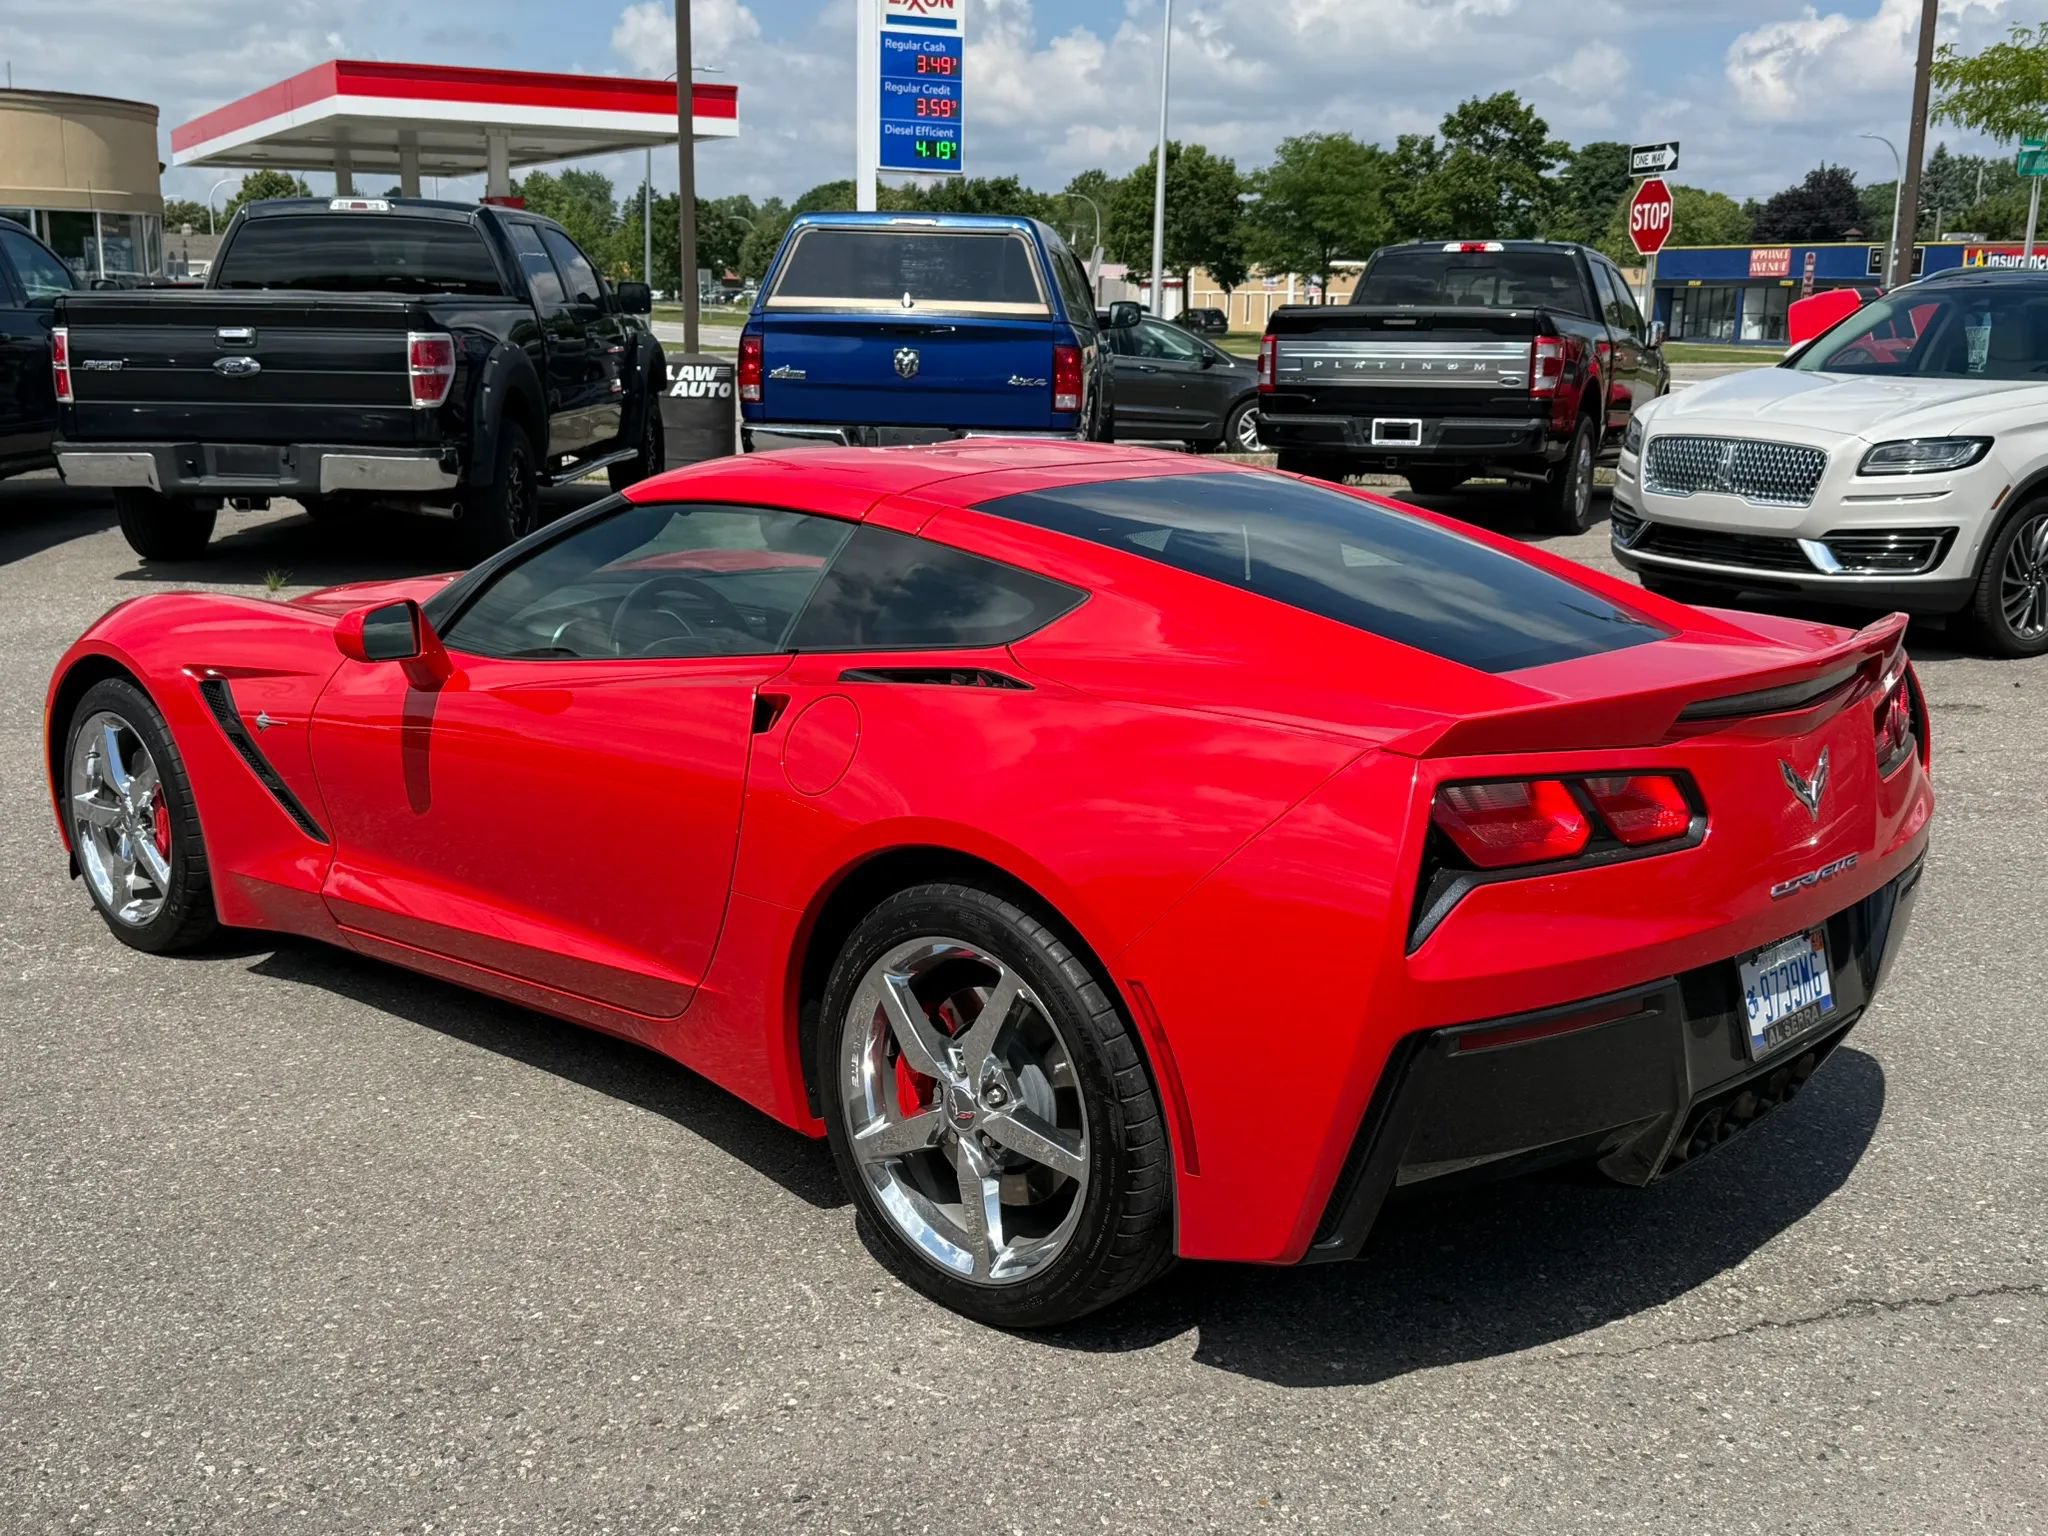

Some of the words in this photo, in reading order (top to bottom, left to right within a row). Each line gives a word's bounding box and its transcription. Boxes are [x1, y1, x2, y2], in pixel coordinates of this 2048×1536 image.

[885, 38, 921, 52] Regular
[923, 41, 946, 52] Cash
[885, 81, 921, 95] Regular
[922, 84, 951, 95] Credit
[885, 124, 914, 135] Diesel
[915, 126, 954, 138] Efficient
[1635, 155, 1649, 166] ONE
[1651, 152, 1665, 163] WAY
[1632, 202, 1670, 231] STOP
[1313, 360, 1487, 371] PLATINUM
[669, 381, 732, 398] AUTO
[1768, 1024, 1784, 1049] AL
[1783, 1005, 1820, 1034] SERRA
